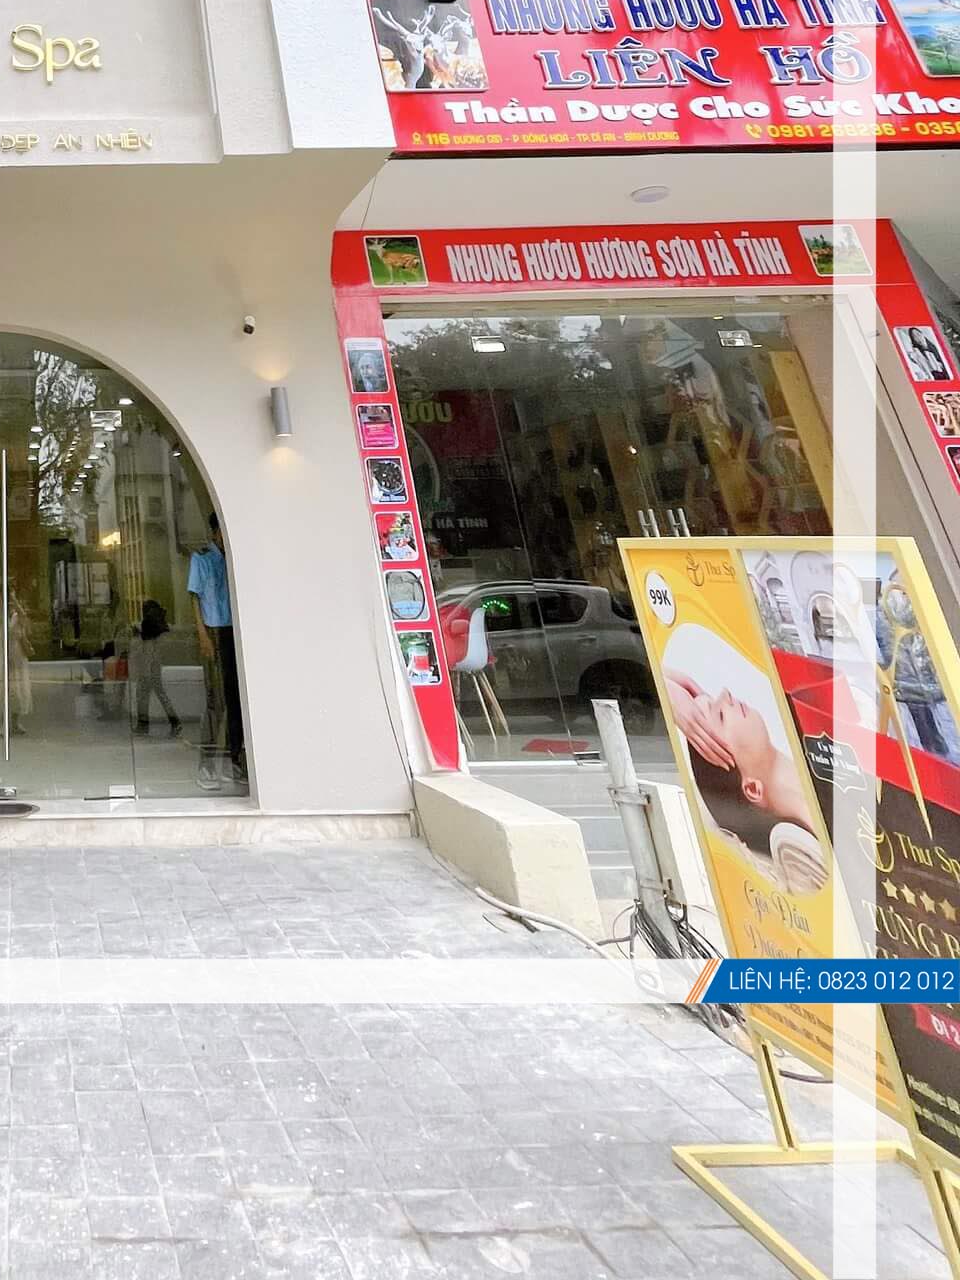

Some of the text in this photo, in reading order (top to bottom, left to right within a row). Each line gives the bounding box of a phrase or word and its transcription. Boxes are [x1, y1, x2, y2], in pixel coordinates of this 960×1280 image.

[10, 23, 104, 86] Spa
[534, 35, 732, 90] LIÊN
[688, 95, 772, 121] Cho
[784, 94, 865, 118] Sức
[53, 132, 83, 151] AN
[767, 124, 814, 138] 0981
[445, 230, 792, 282] NHUNG HƯƠU HƯƠNG SƠN HÀ TĨNH
[649, 589, 672, 606] 99K
[935, 845, 960, 884] Sp
